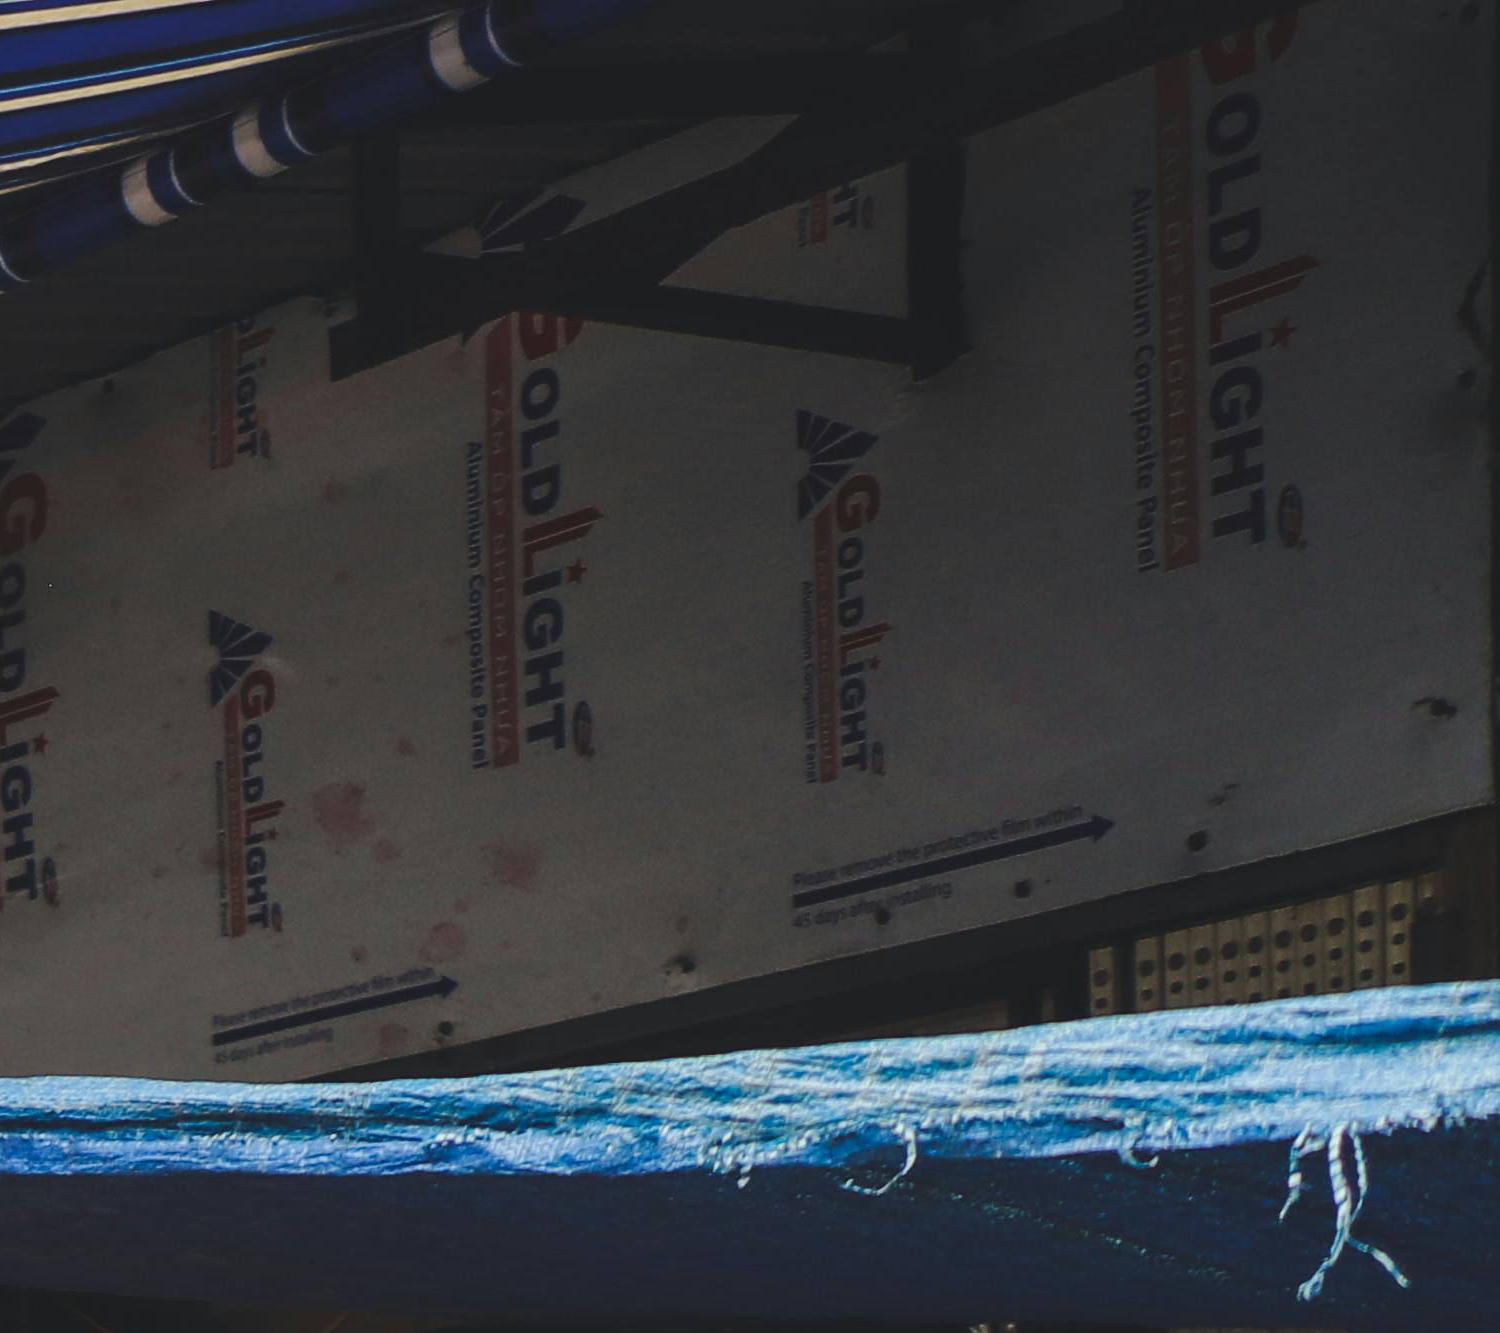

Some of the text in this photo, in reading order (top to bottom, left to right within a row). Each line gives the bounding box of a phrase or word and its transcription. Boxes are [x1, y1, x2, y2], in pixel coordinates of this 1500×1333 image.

[1130, 188, 1161, 572] Aluminium Composite Panel
[467, 442, 491, 769] Aluminium Composite Panel
